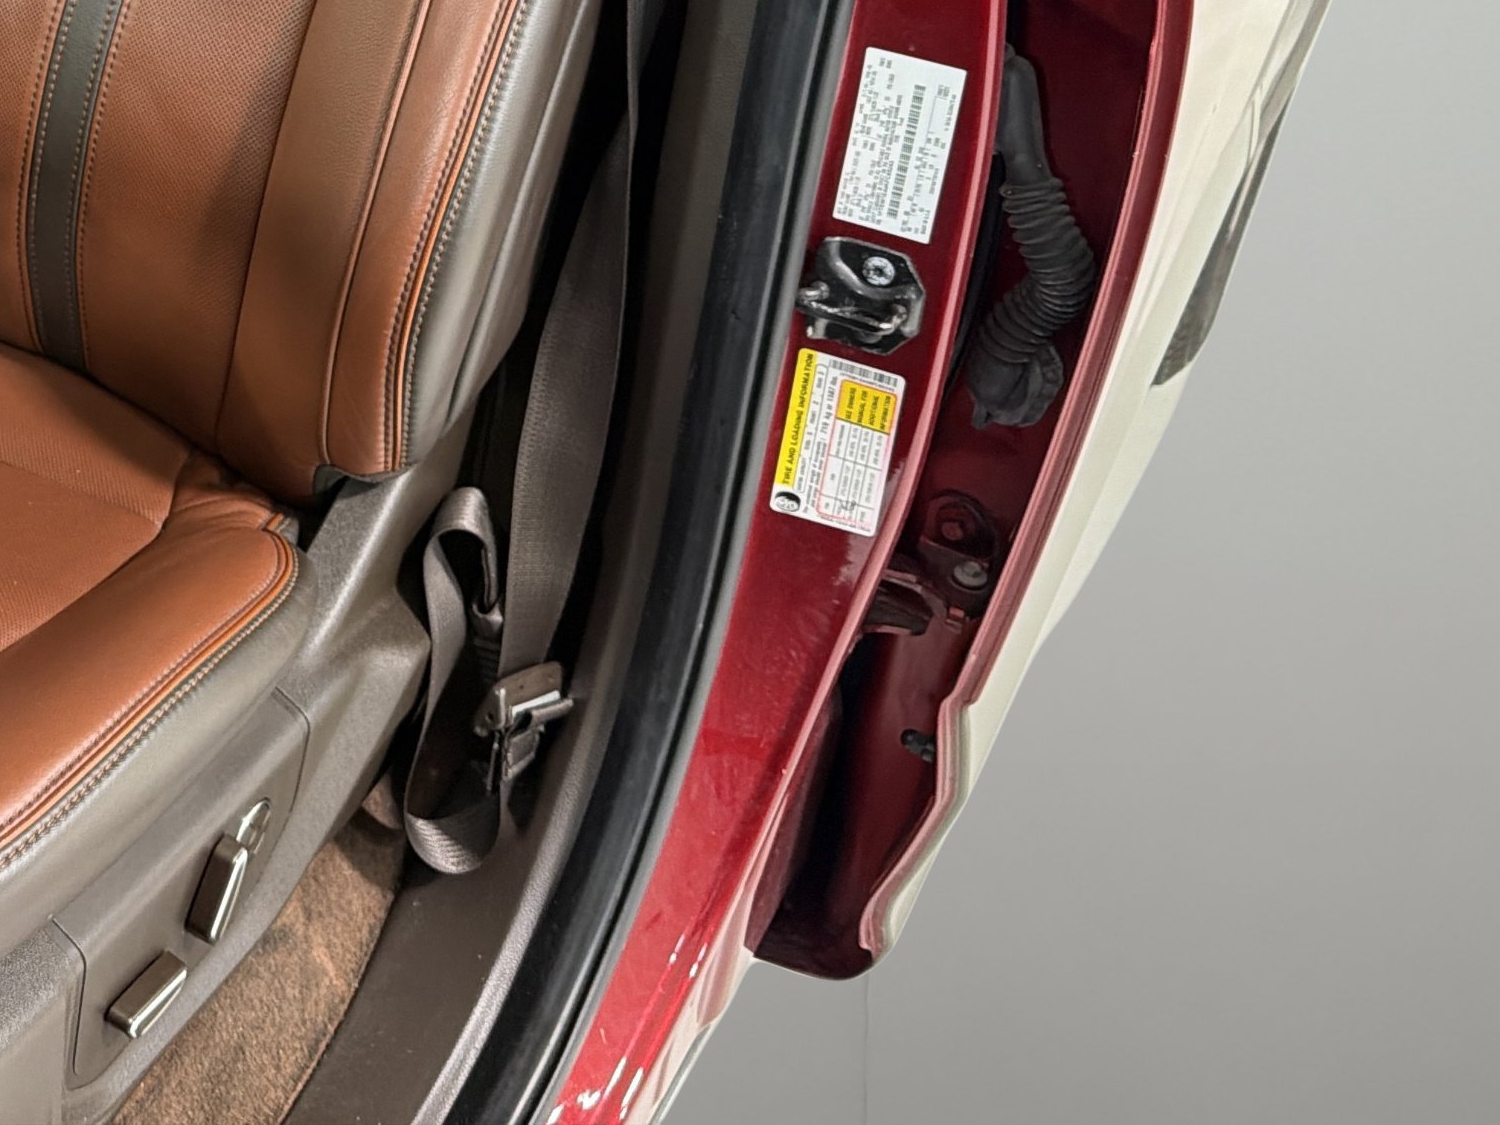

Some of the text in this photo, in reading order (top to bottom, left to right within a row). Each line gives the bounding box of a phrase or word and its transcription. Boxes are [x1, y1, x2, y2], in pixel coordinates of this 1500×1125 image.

[799, 352, 813, 407] INFORMATION
[790, 410, 802, 445] LOADING
[786, 447, 795, 464] AND
[782, 465, 792, 484] TIRE
